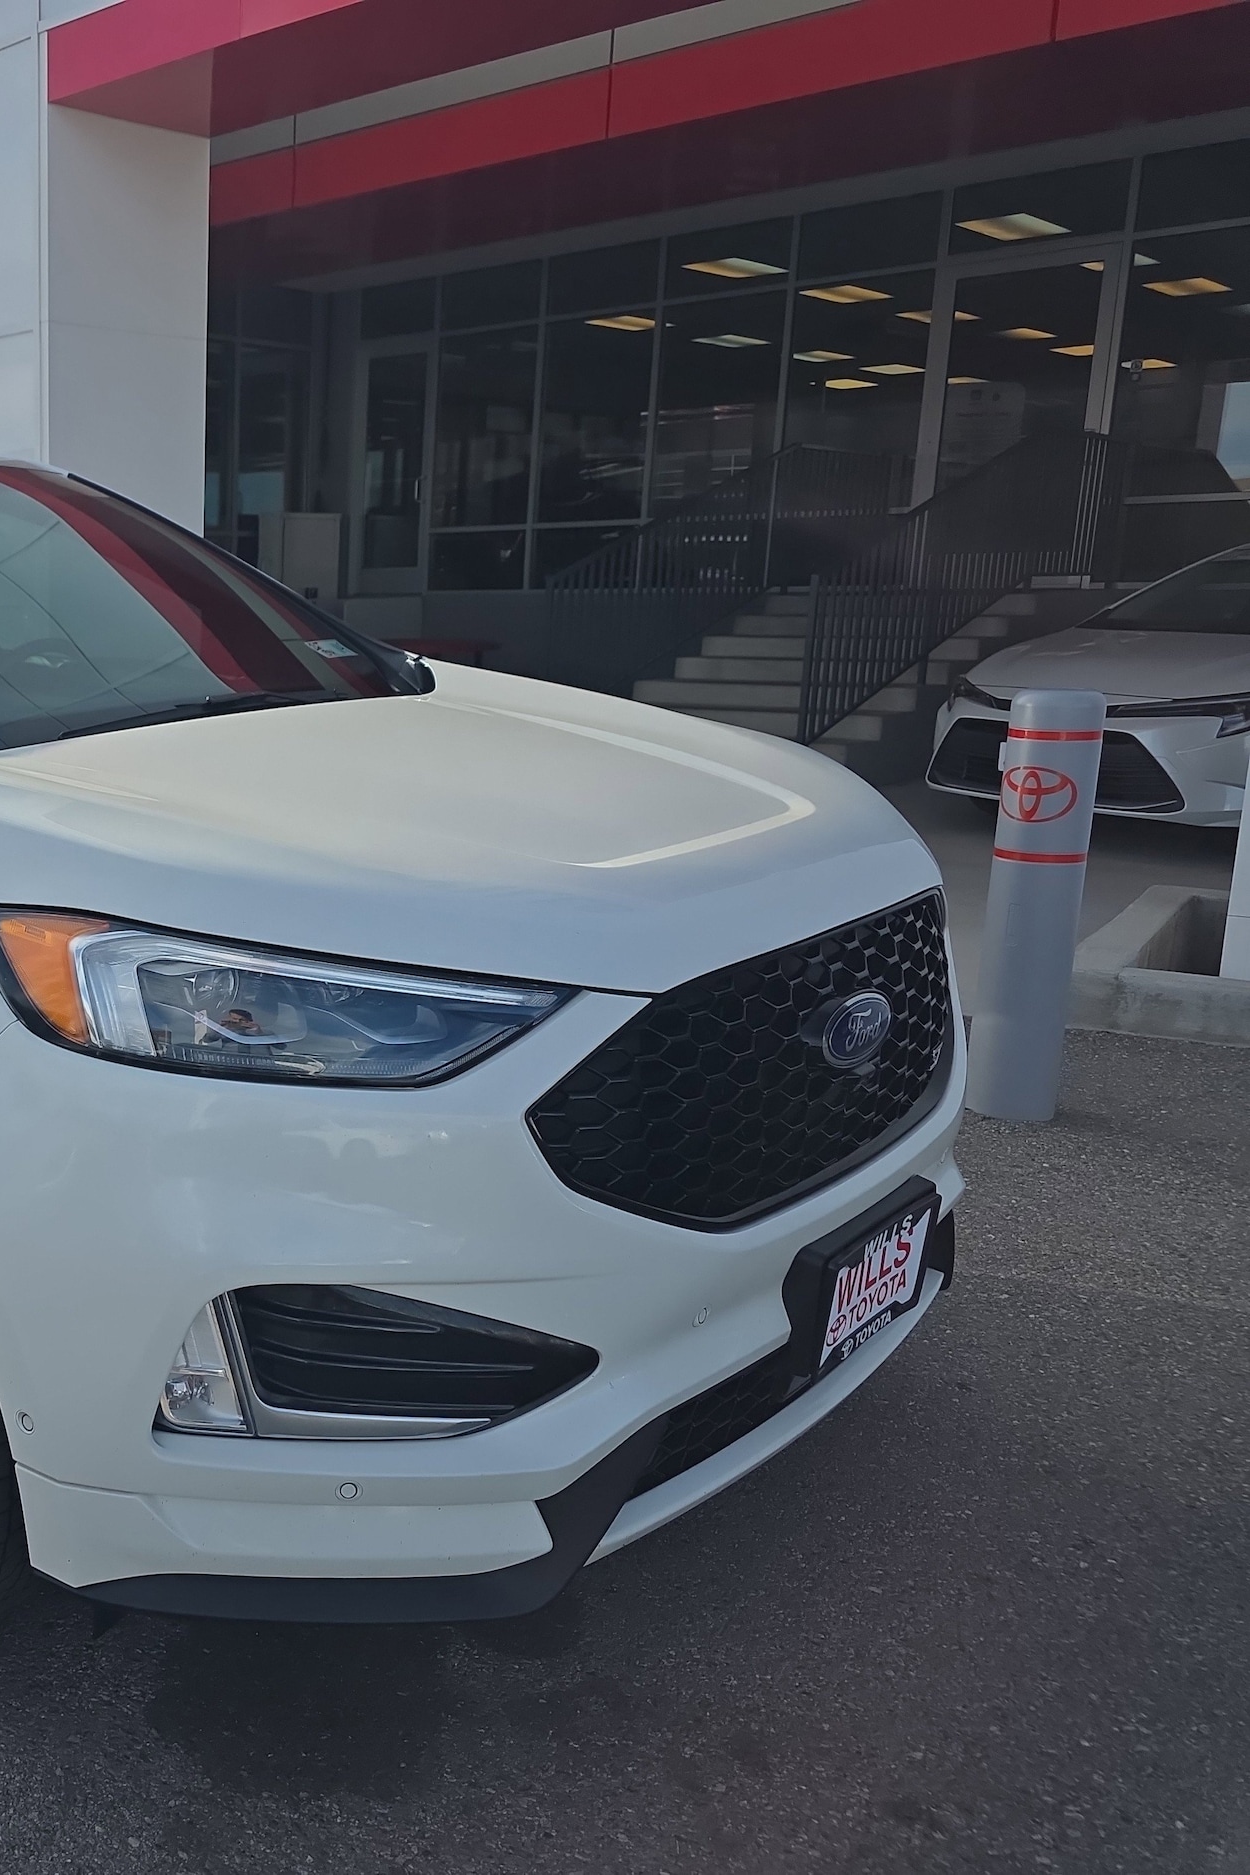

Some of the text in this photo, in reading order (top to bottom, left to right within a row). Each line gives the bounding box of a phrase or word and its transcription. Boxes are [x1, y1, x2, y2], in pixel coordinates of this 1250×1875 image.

[845, 1008, 882, 1053] Ford
[863, 1213, 914, 1261] WILLS
[837, 1228, 914, 1314] WILLS
[848, 1268, 908, 1329] TOYOTA
[854, 1309, 893, 1348] TOYOTA
